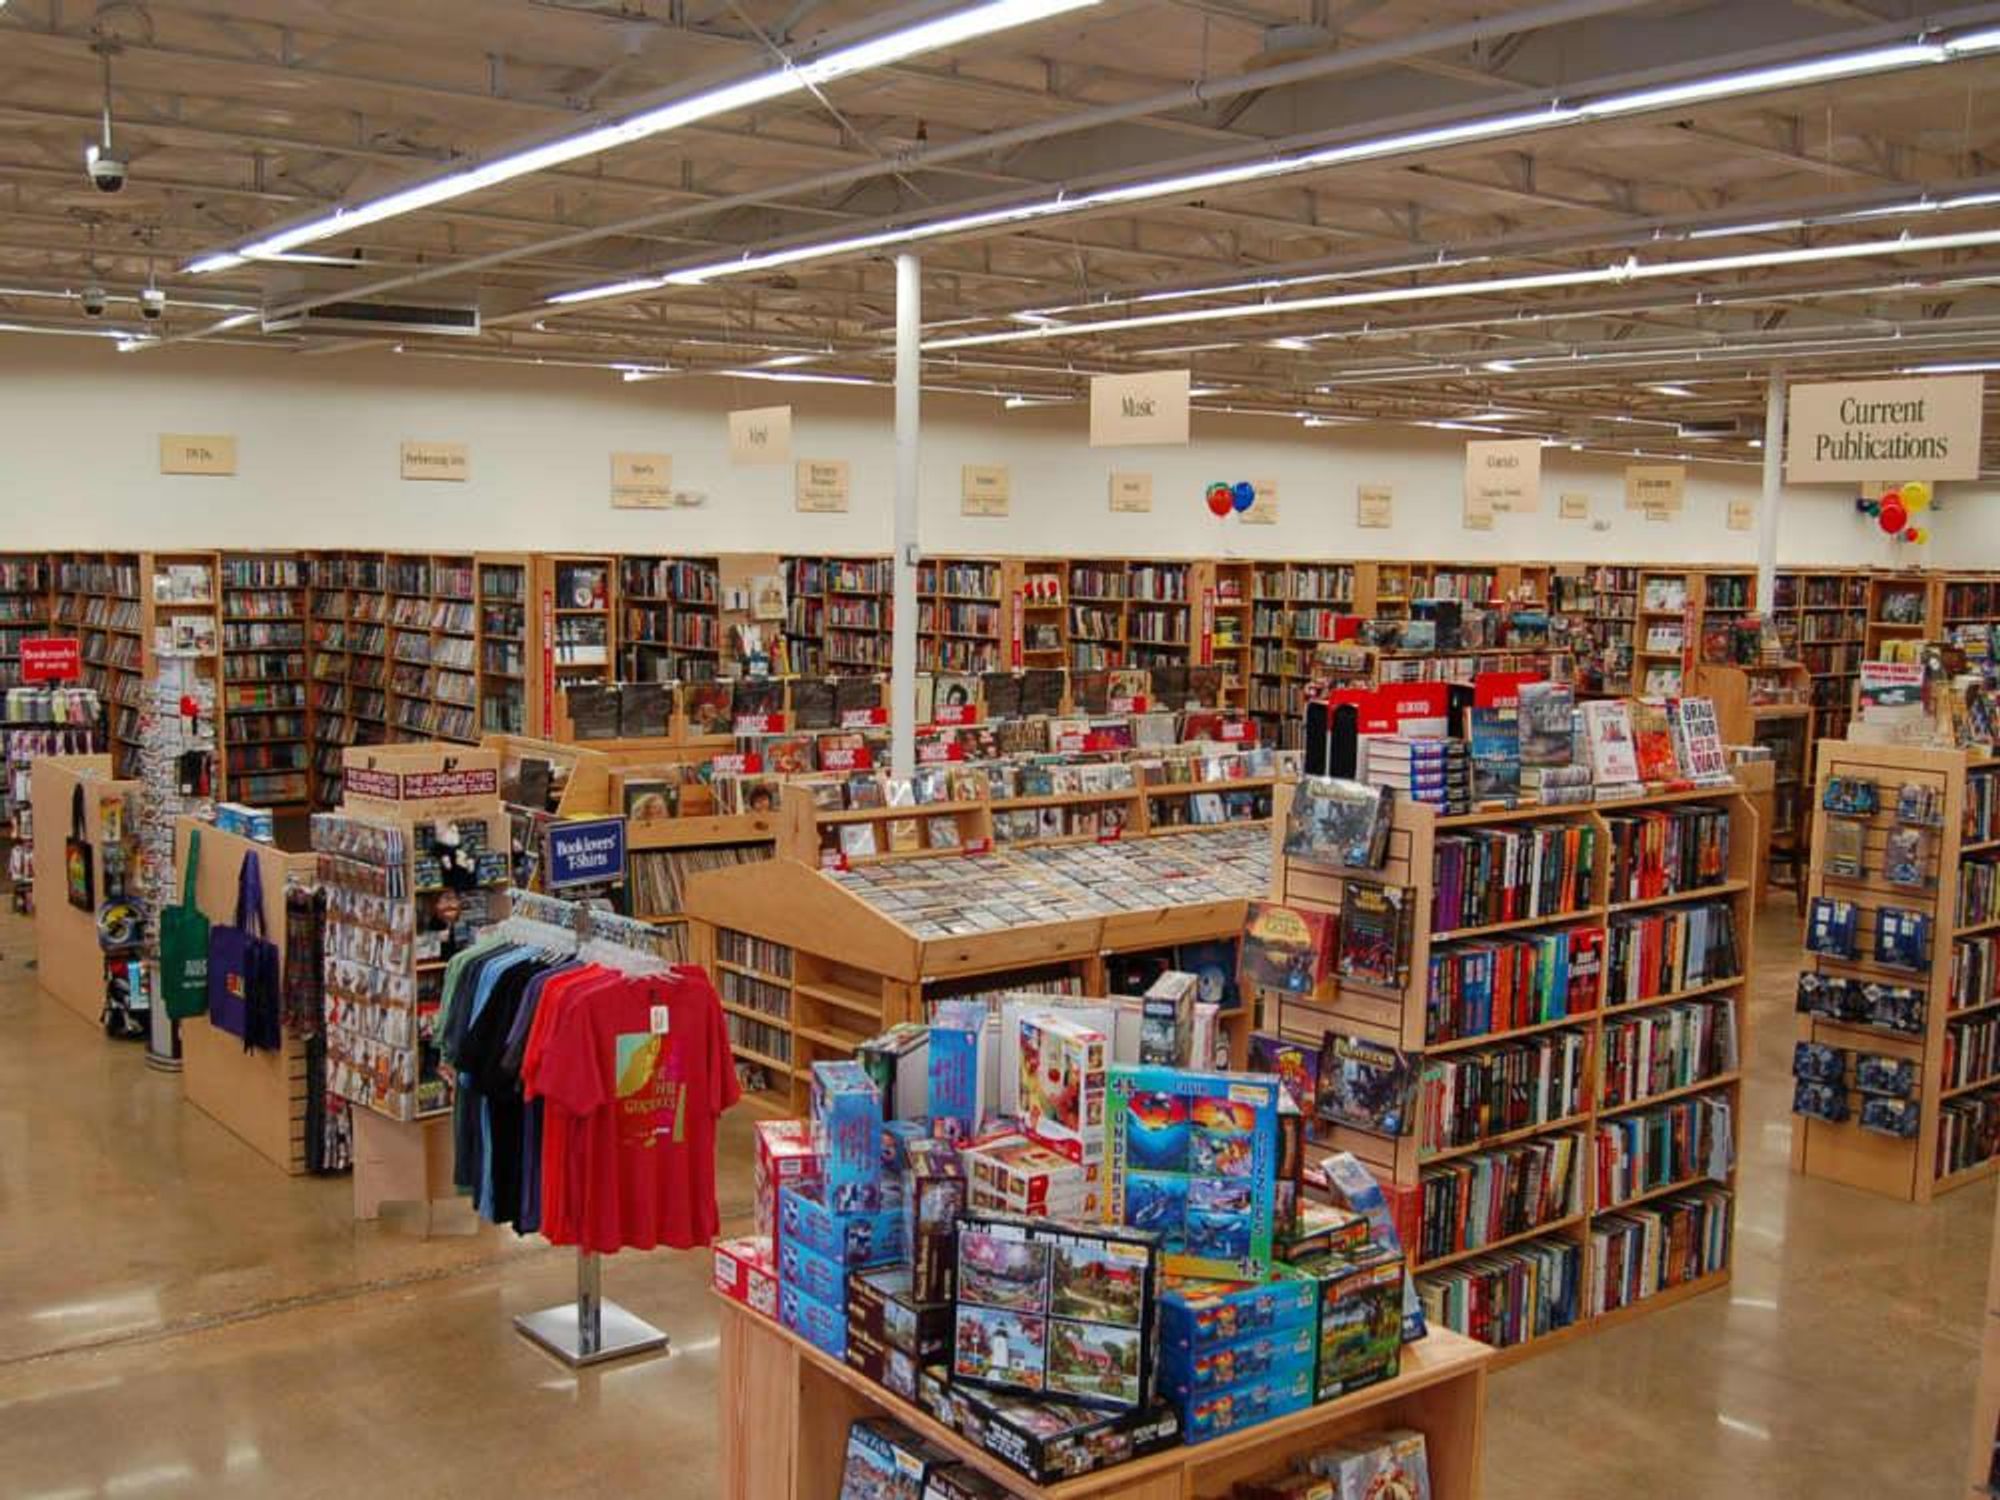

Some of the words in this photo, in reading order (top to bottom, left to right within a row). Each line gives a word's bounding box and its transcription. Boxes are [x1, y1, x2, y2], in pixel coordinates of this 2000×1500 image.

[1121, 395, 1156, 417] Music
[1839, 397, 1924, 425] Current
[1815, 431, 1949, 461] Publications
[566, 851, 608, 871] T-Shirts
